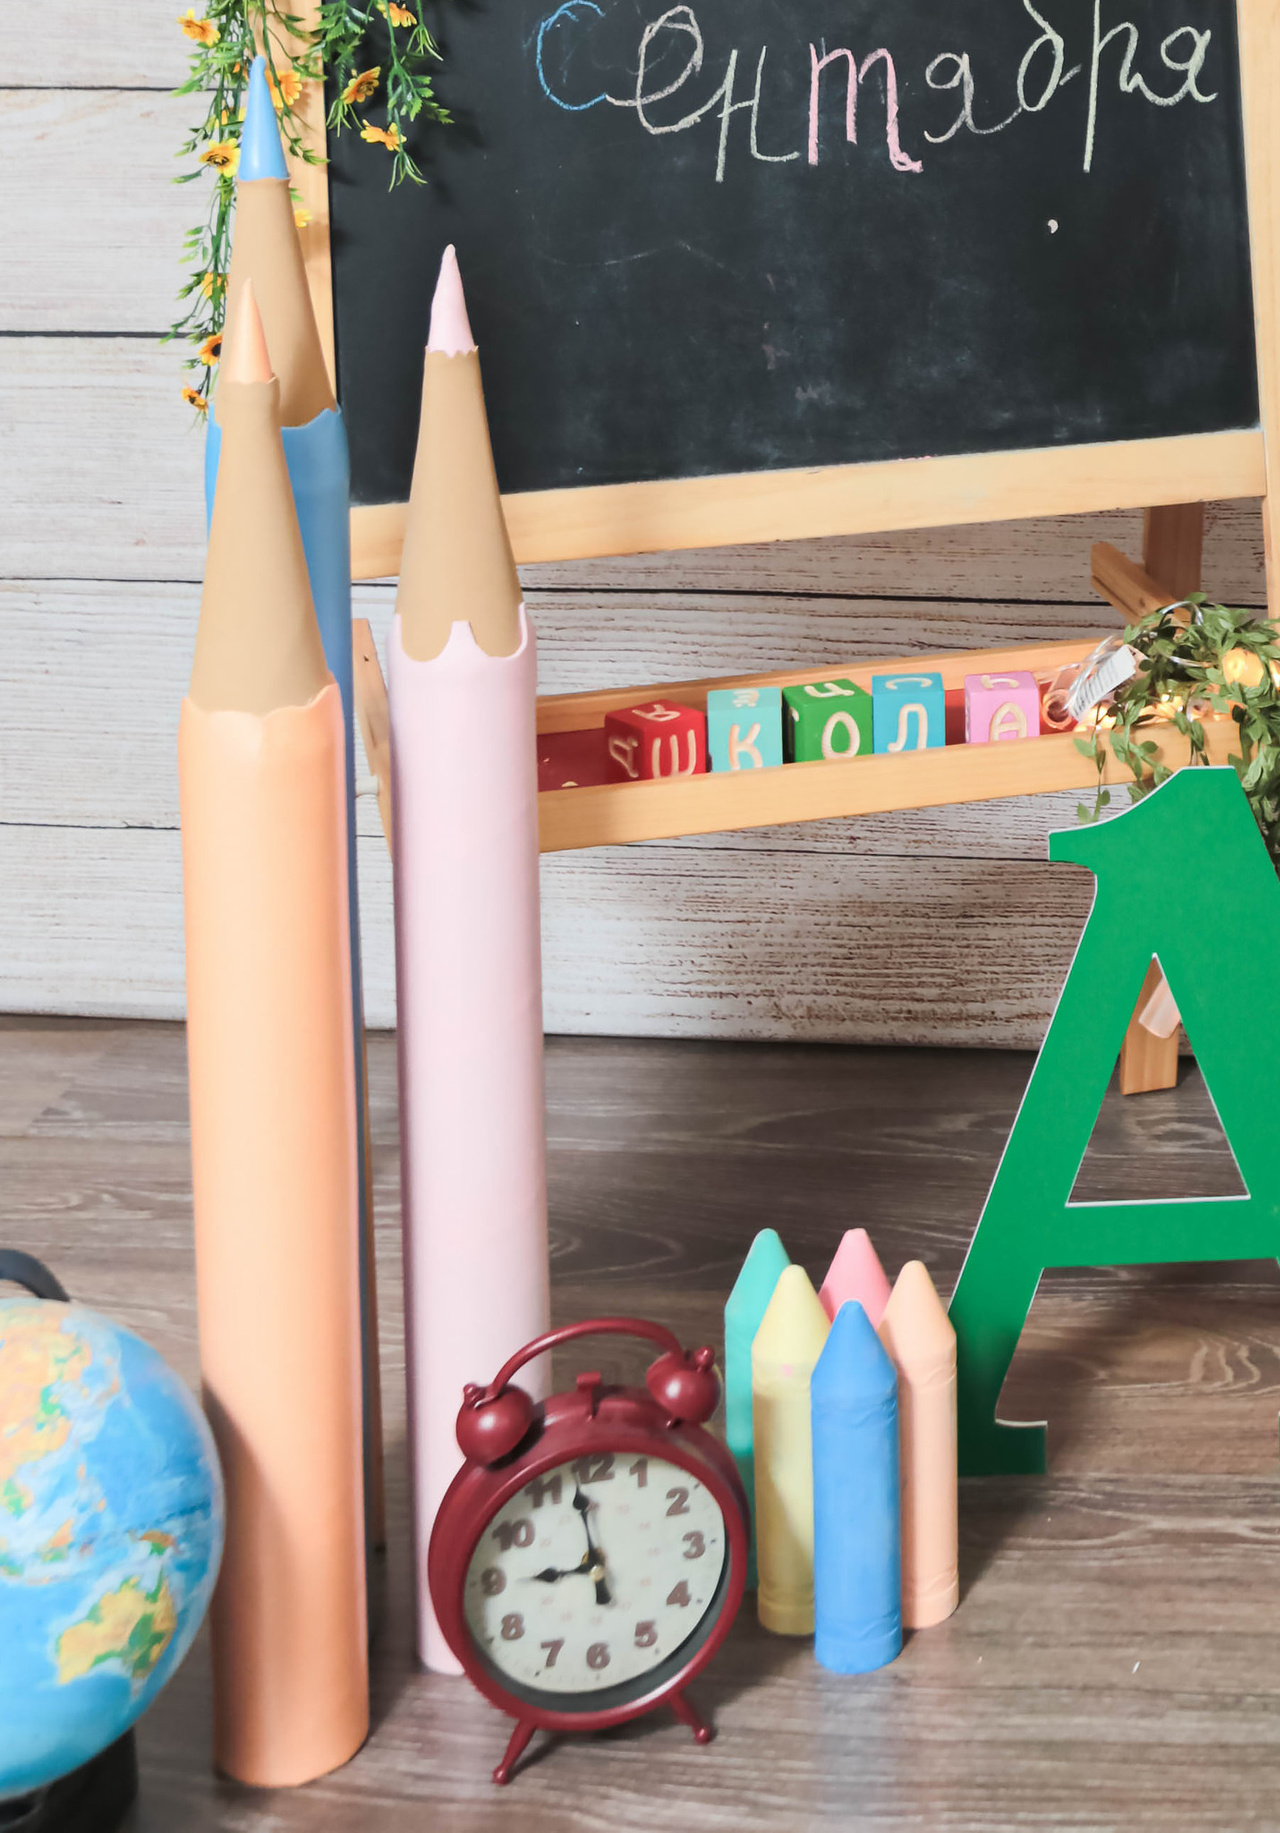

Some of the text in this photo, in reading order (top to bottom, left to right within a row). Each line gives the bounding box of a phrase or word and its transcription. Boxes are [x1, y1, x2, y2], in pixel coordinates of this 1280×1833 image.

[652, 701, 1028, 779] ШКОЛА
[629, 1458, 649, 1488] 1
[524, 1474, 563, 1509] 11
[665, 1487, 691, 1517] 2
[491, 1519, 536, 1552] 10
[682, 1530, 706, 1559] 3
[481, 1568, 507, 1596] 9
[665, 1580, 692, 1608] 4
[500, 1613, 526, 1641] 8
[634, 1620, 659, 1648] 5
[540, 1638, 565, 1668] 7
[586, 1642, 611, 1670] 6
